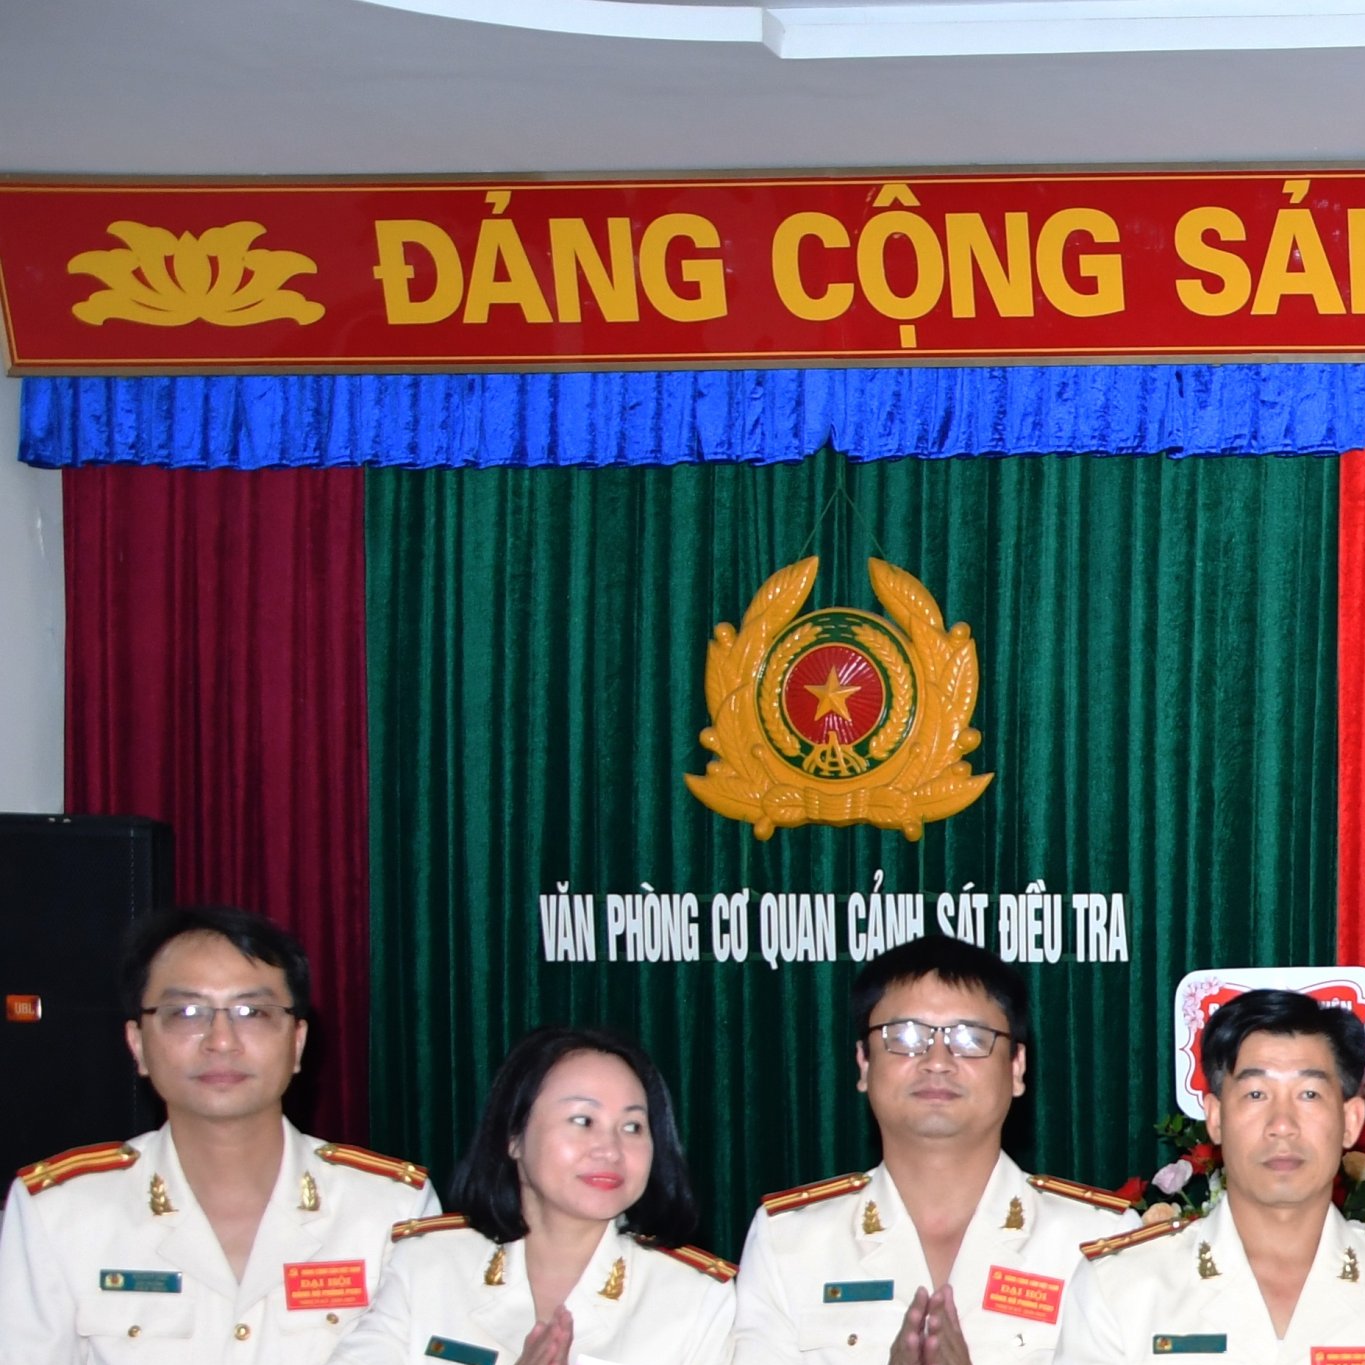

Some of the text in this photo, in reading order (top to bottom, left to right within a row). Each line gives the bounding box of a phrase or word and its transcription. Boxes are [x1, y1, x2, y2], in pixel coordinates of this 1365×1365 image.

[374, 190, 728, 325] ĐẢNG
[772, 183, 1125, 347] CỘNG
[540, 868, 1129, 970] VĂN PHÒNG CƠ QUAN CẢNH SÁT ĐIỀU TRA
